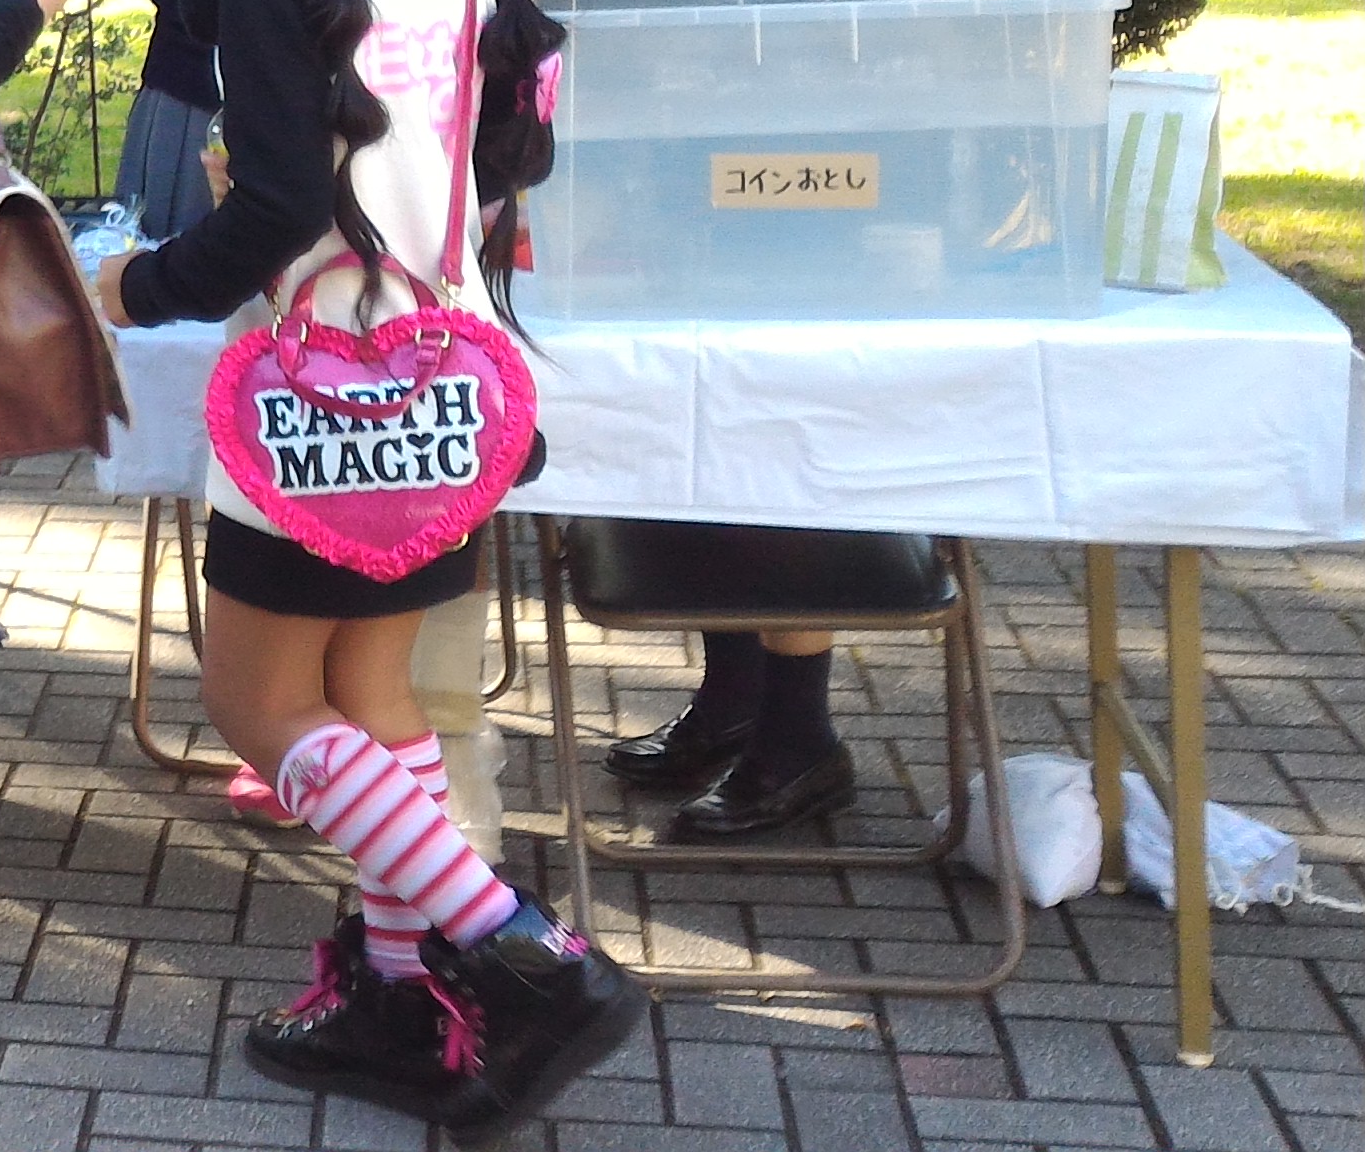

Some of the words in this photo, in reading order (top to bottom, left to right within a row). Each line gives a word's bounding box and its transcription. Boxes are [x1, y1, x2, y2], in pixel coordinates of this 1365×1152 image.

[725, 167, 866, 194] コインおとし
[263, 381, 477, 439] EARTH
